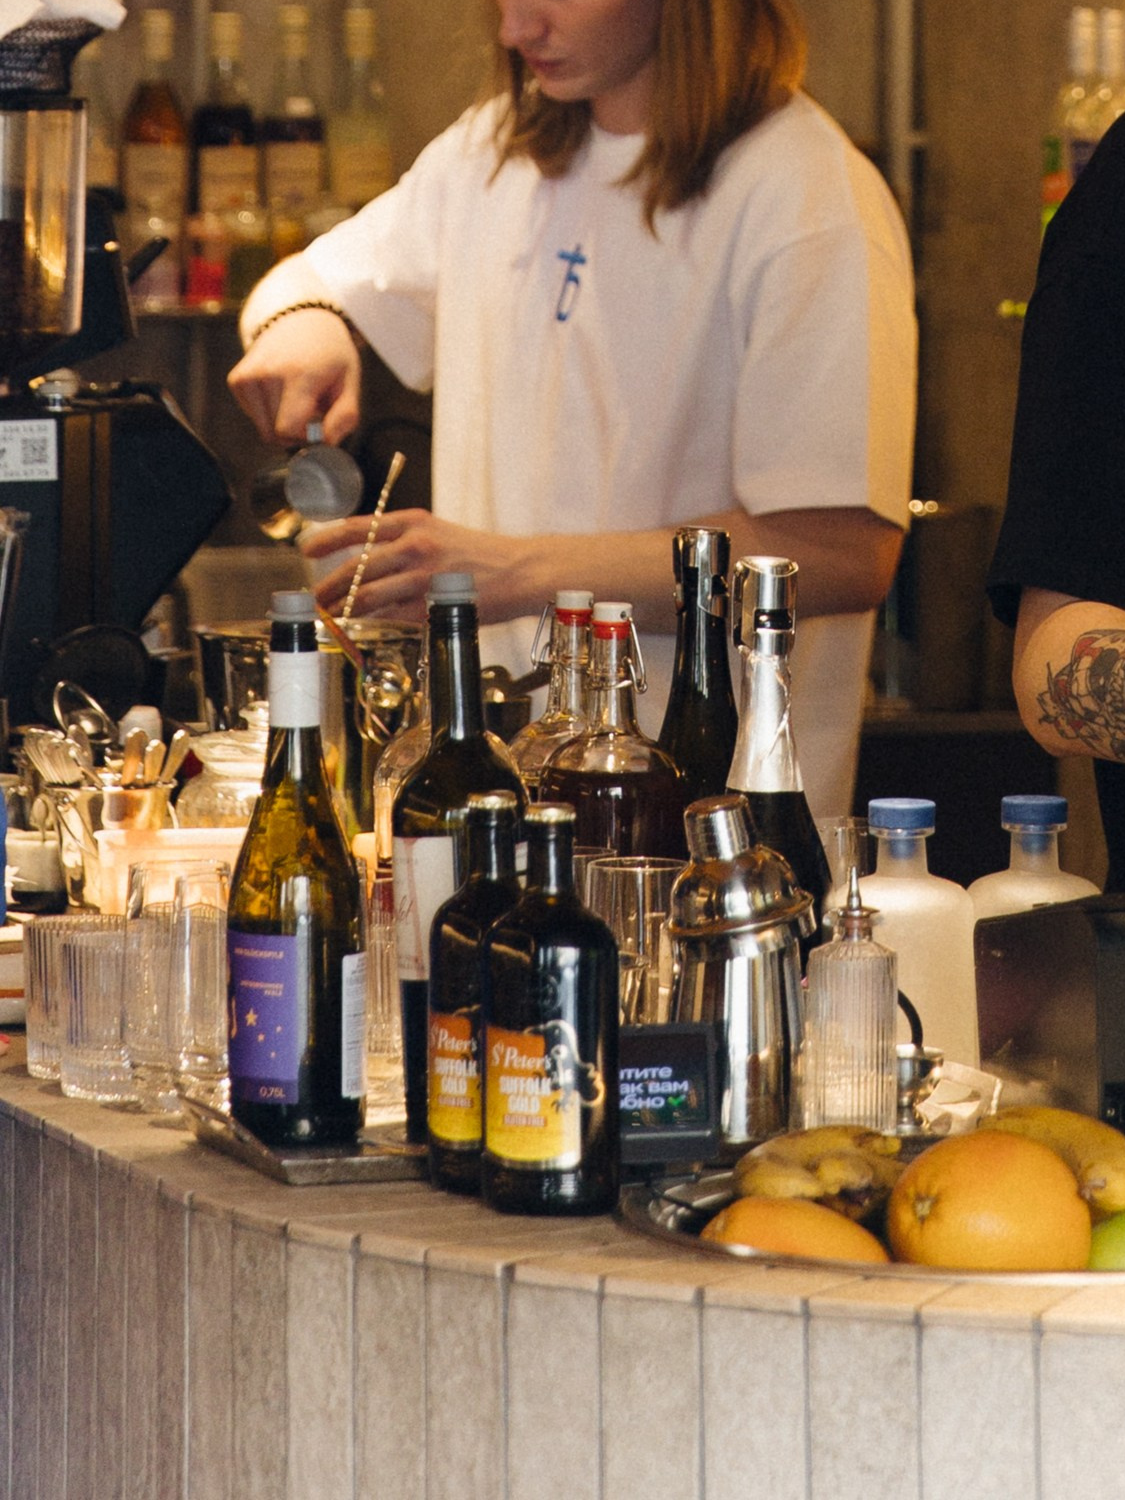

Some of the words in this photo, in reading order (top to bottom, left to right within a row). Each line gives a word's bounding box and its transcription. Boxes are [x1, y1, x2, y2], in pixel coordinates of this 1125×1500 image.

[504, 1046, 551, 1070] Peter's
[500, 1075, 551, 1096] SUFFOLK
[620, 1082, 644, 1096] ак
[508, 1095, 540, 1115] GOLD
